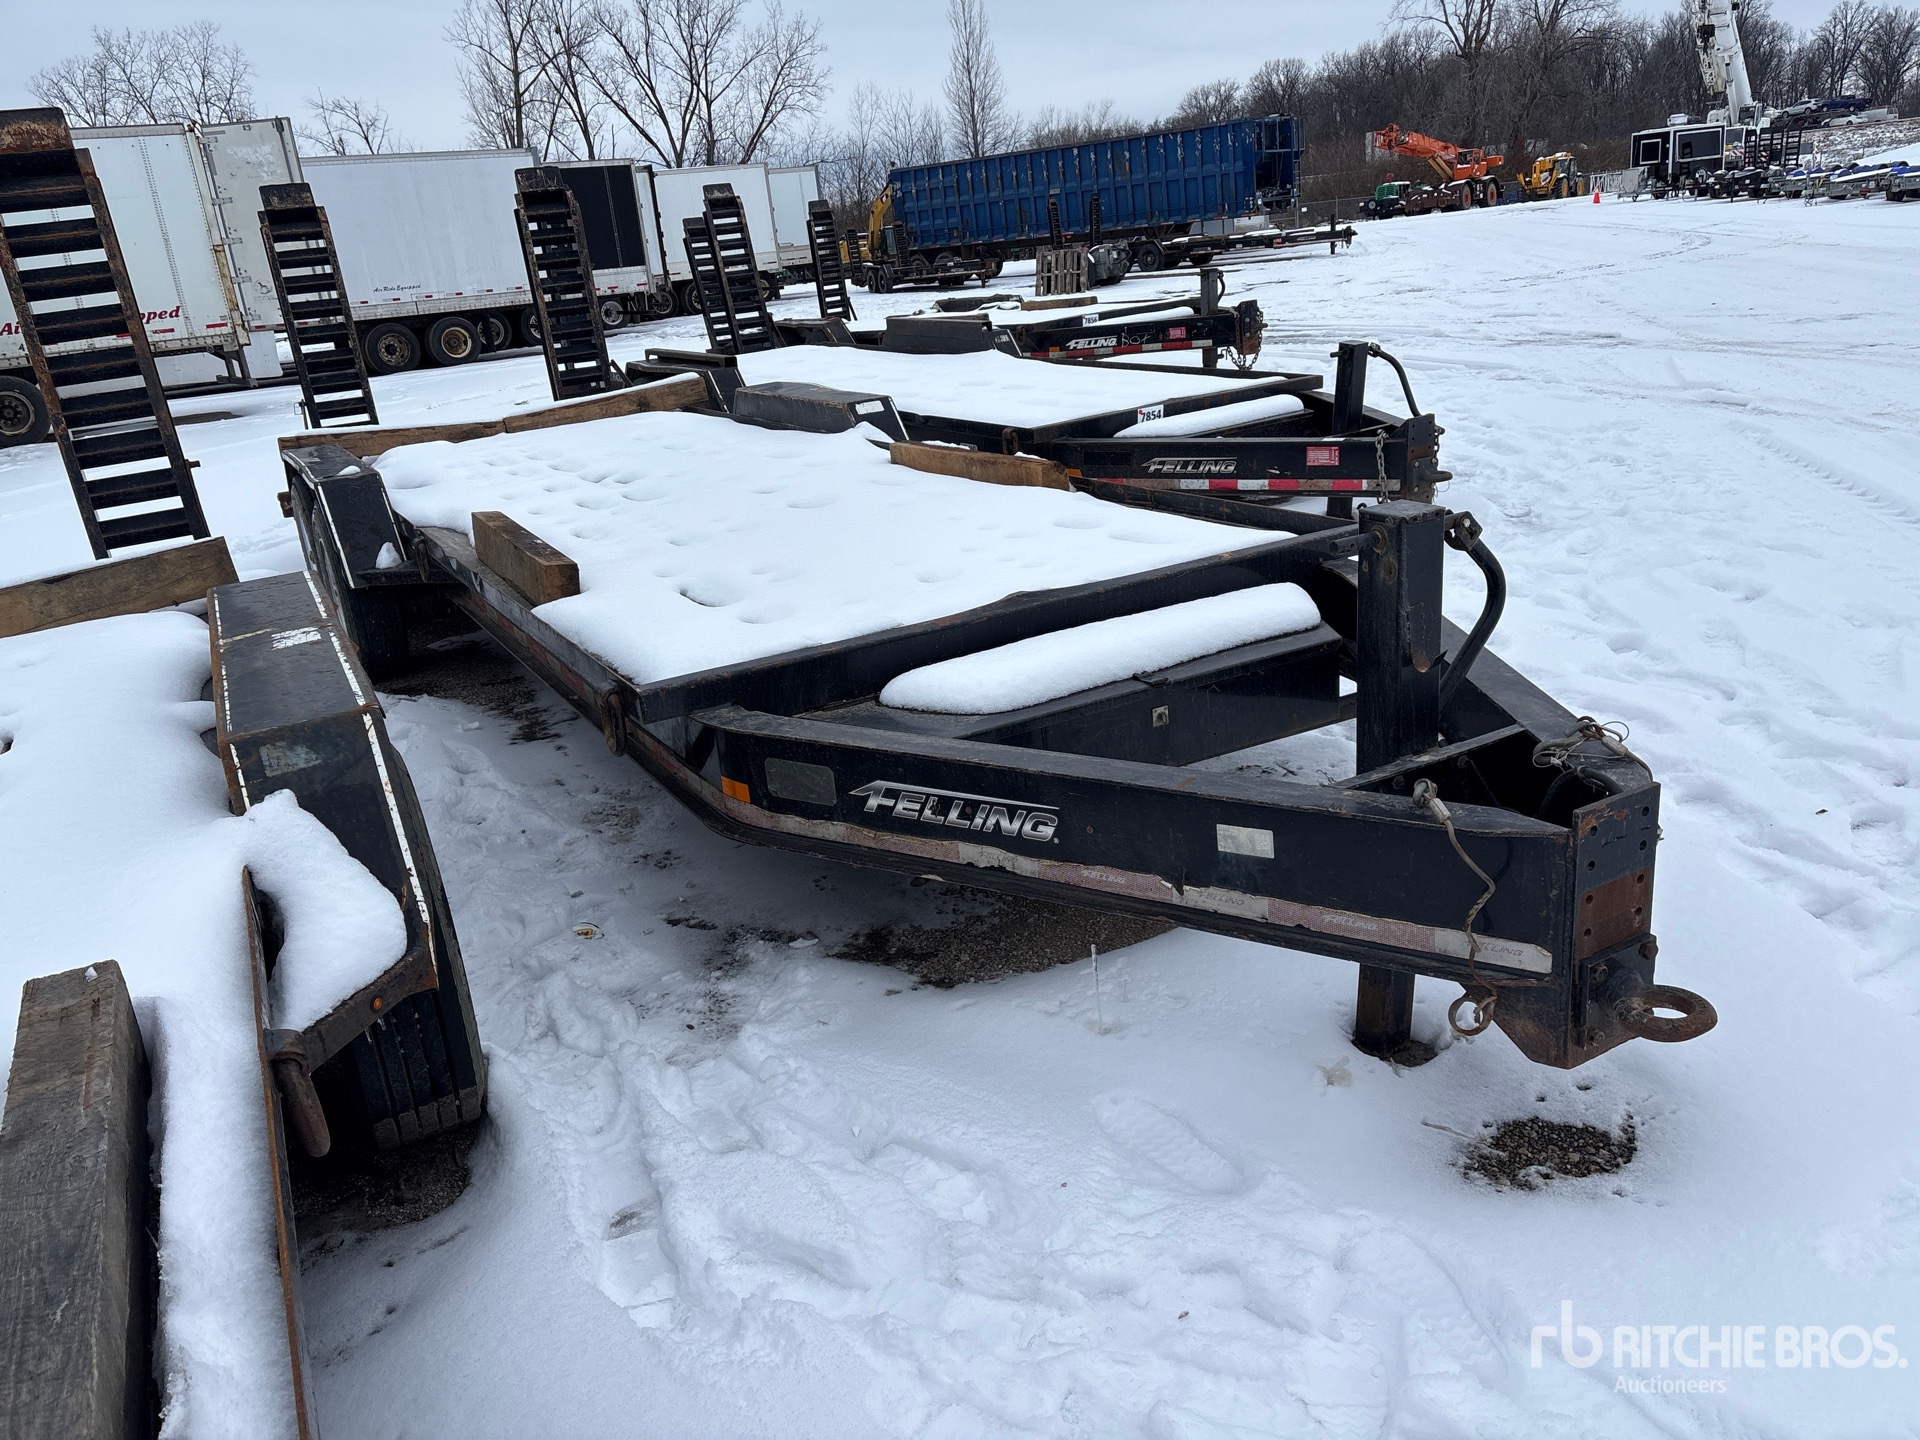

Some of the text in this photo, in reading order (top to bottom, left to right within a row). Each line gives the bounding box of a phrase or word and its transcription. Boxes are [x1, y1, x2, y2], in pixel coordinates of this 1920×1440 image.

[0, 322, 21, 336] Ai
[1066, 335, 1118, 349] FELLING
[1141, 409, 1161, 422] 7854
[1141, 457, 1238, 474] FELLING
[849, 780, 1060, 844] FELLING
